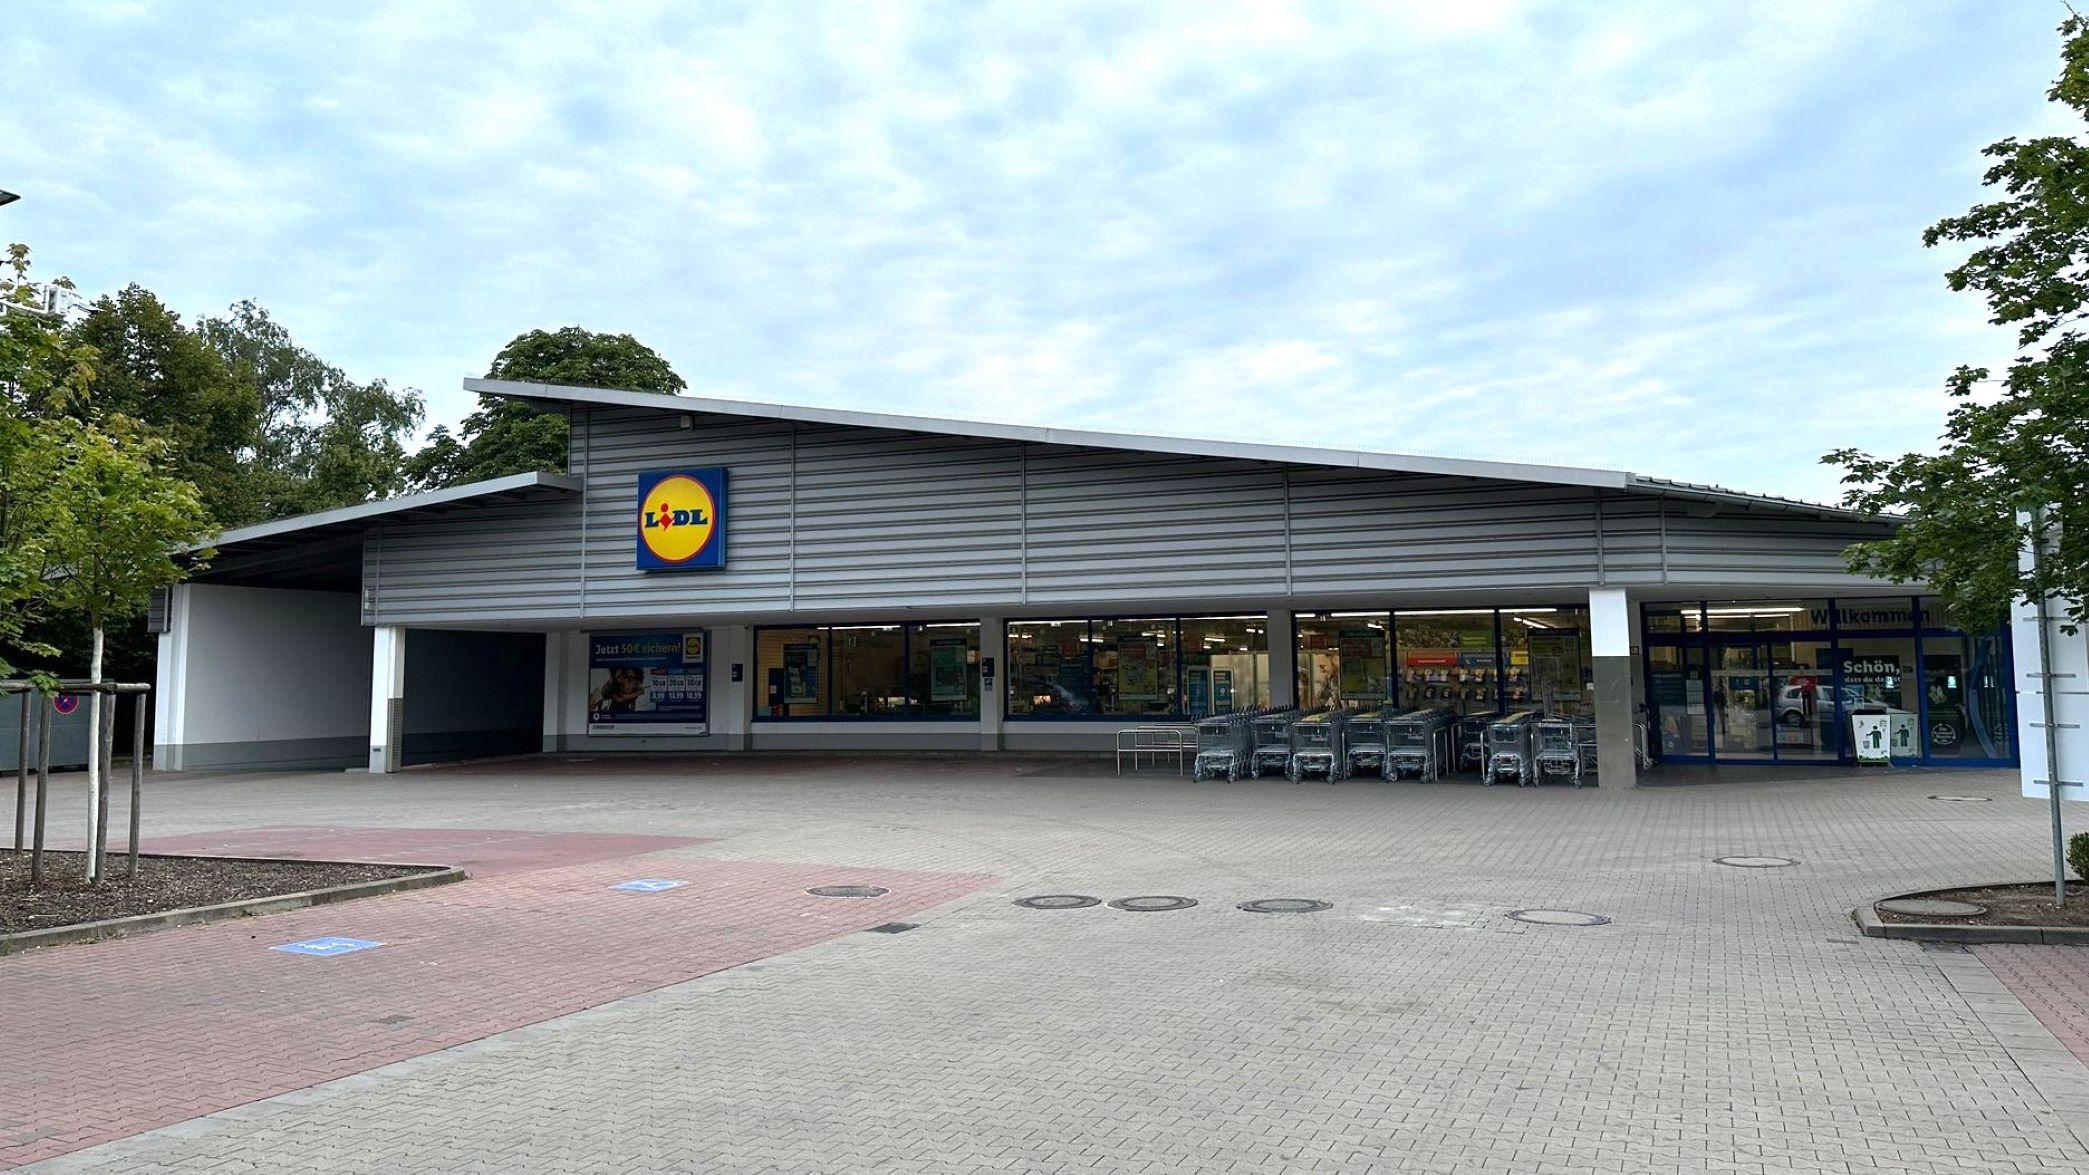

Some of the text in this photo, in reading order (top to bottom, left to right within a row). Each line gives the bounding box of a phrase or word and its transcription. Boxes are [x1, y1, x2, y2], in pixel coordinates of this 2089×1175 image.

[1811, 608, 1929, 624] Wllkommn
[595, 644, 619, 655] Jetzt
[641, 642, 682, 654] sichern!
[1843, 660, 1901, 675] Schön,
